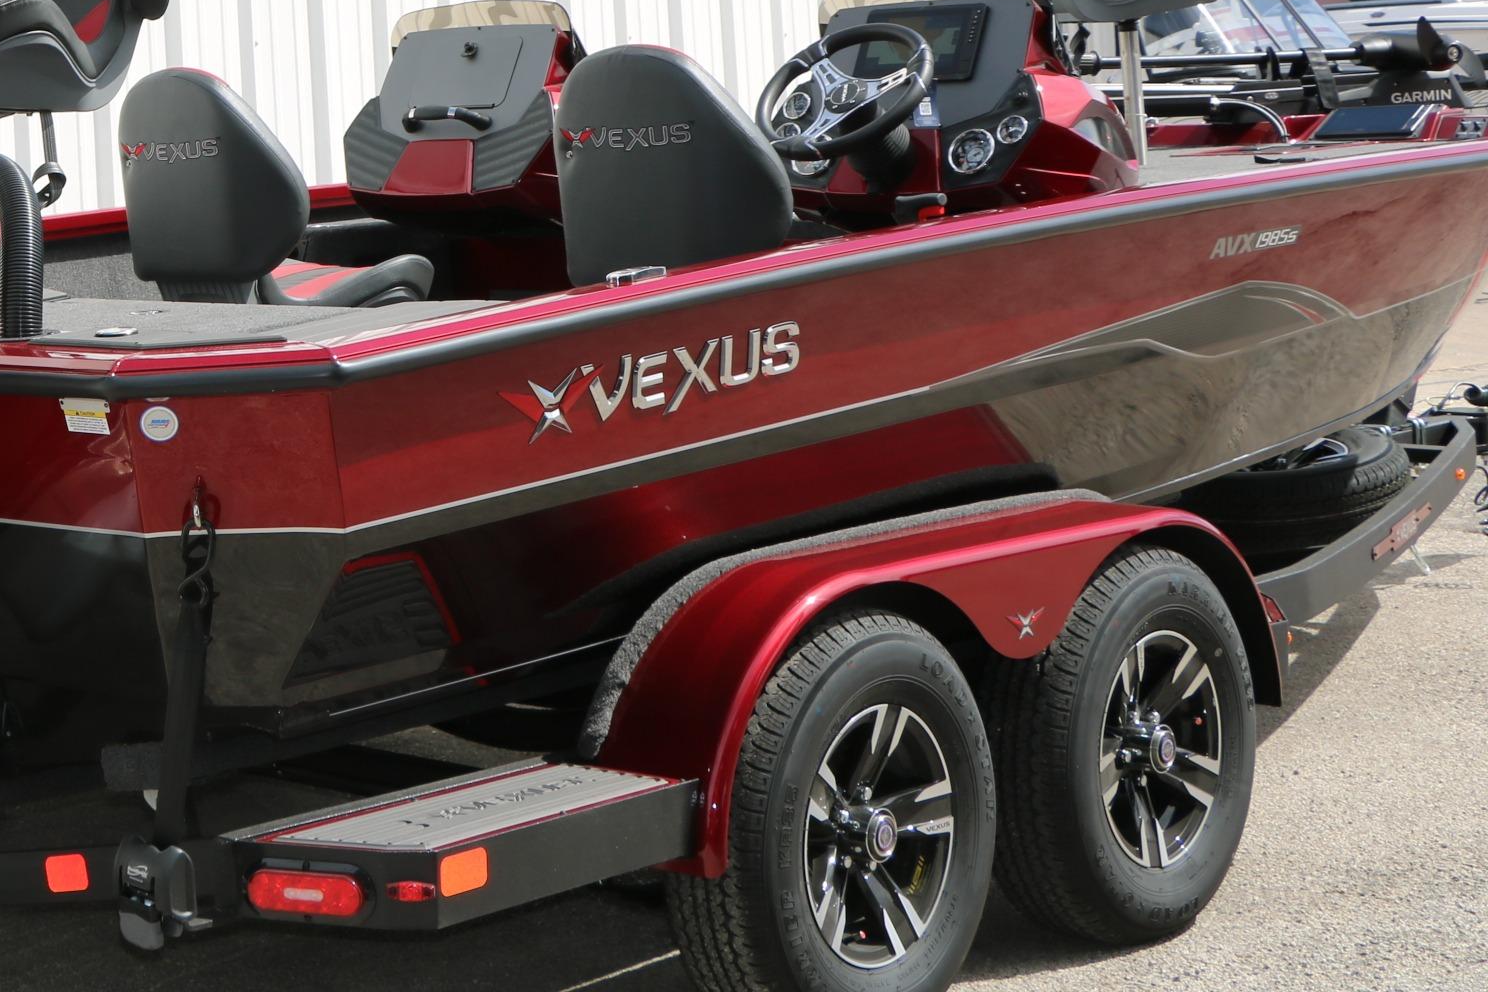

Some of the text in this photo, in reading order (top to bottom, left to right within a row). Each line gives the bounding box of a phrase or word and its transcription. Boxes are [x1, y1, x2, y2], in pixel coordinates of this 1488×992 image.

[1390, 88, 1453, 105] GARMIN
[587, 121, 692, 151] VEXUS
[139, 138, 220, 164] VEXUS
[1209, 232, 1257, 260] AVX
[581, 320, 801, 423] VEXUS
[925, 821, 951, 833] VEXUS
